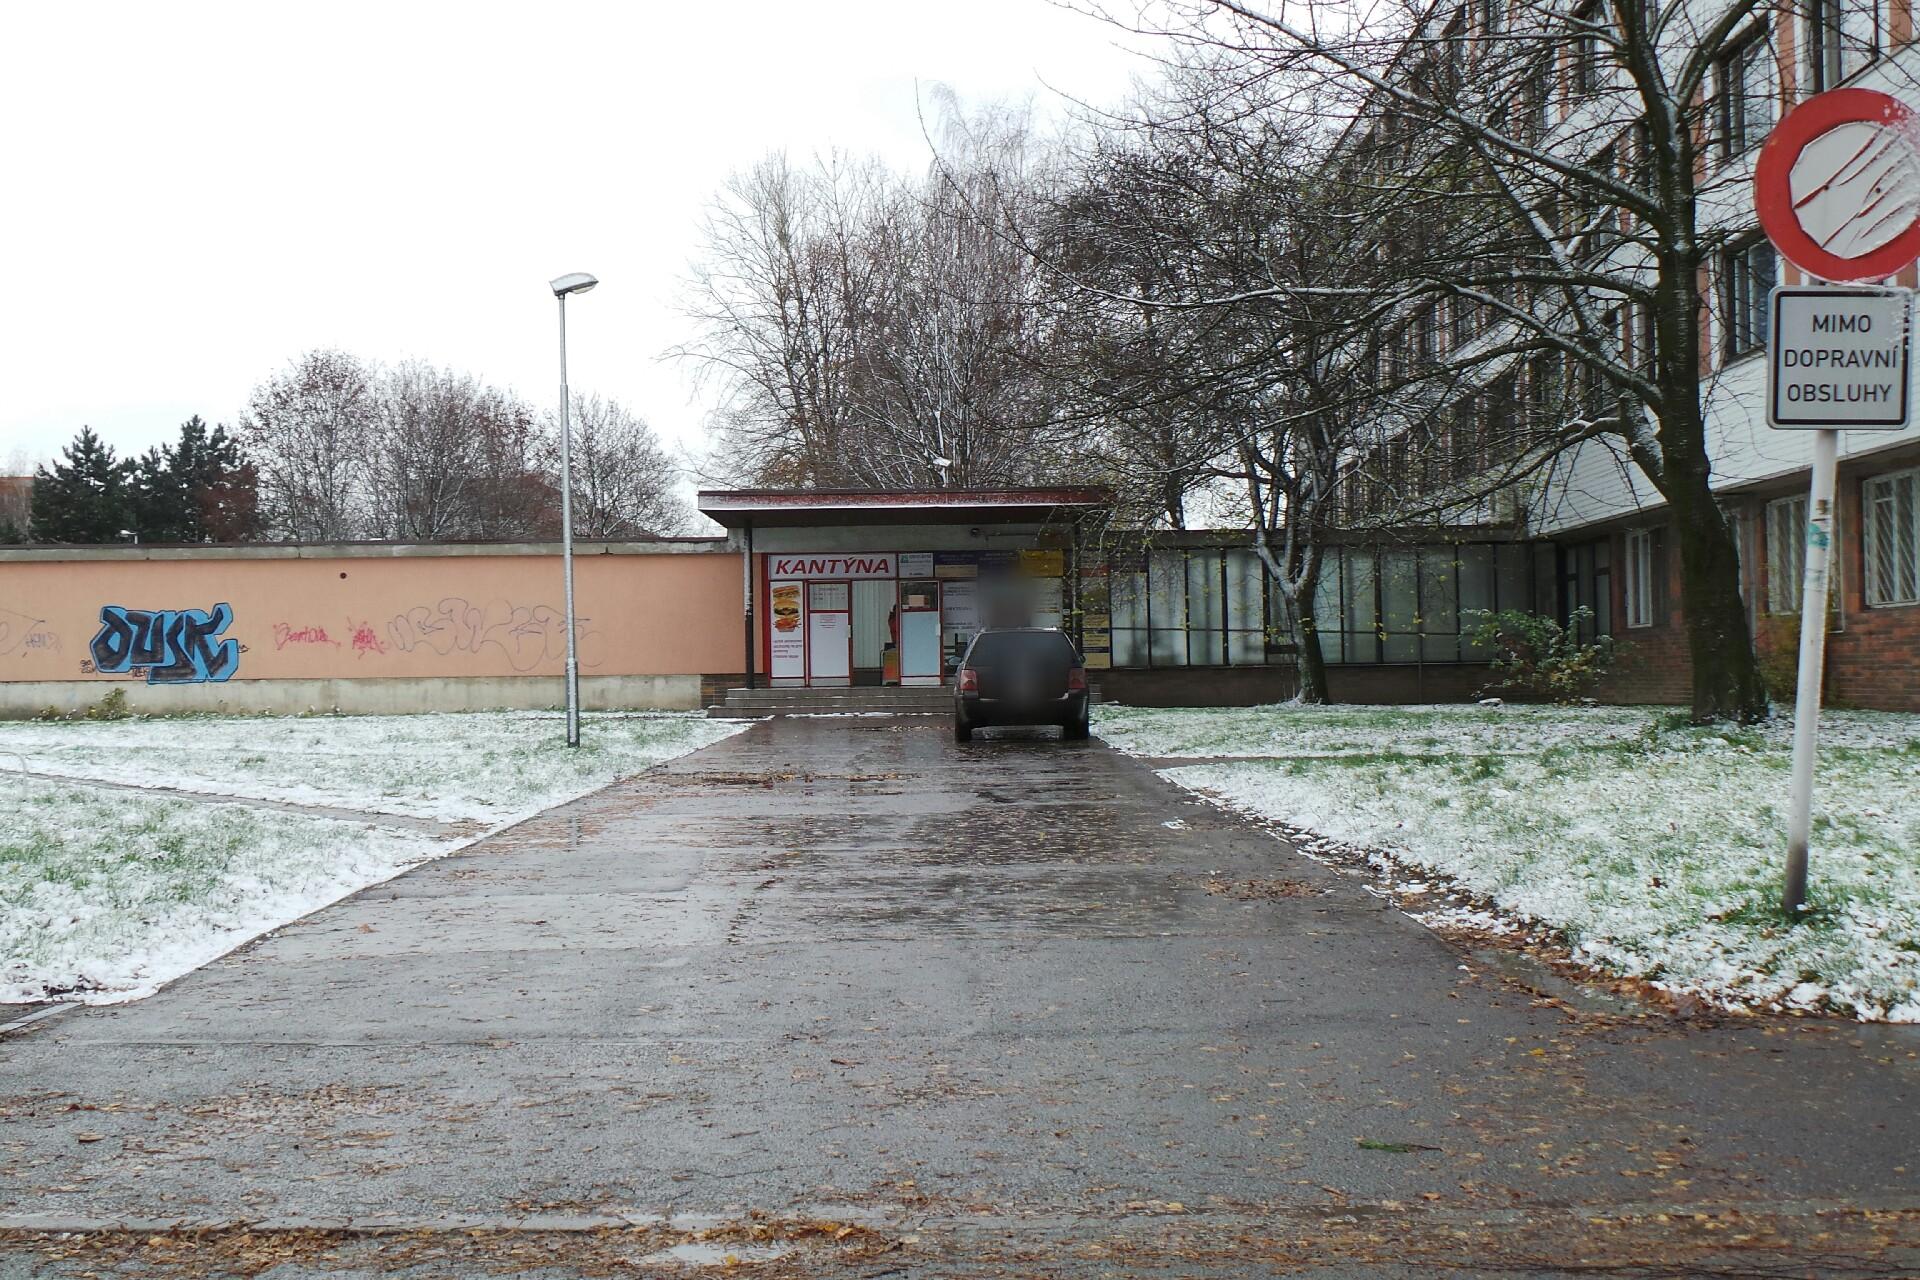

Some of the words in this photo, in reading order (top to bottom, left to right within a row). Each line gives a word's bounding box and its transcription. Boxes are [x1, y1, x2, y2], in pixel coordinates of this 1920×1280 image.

[1812, 314, 1871, 333] MIMO
[1784, 344, 1899, 368] DOPRAVNÍ
[1787, 383, 1892, 402] OBSLUHY
[775, 556, 890, 575] KANTÝNA
